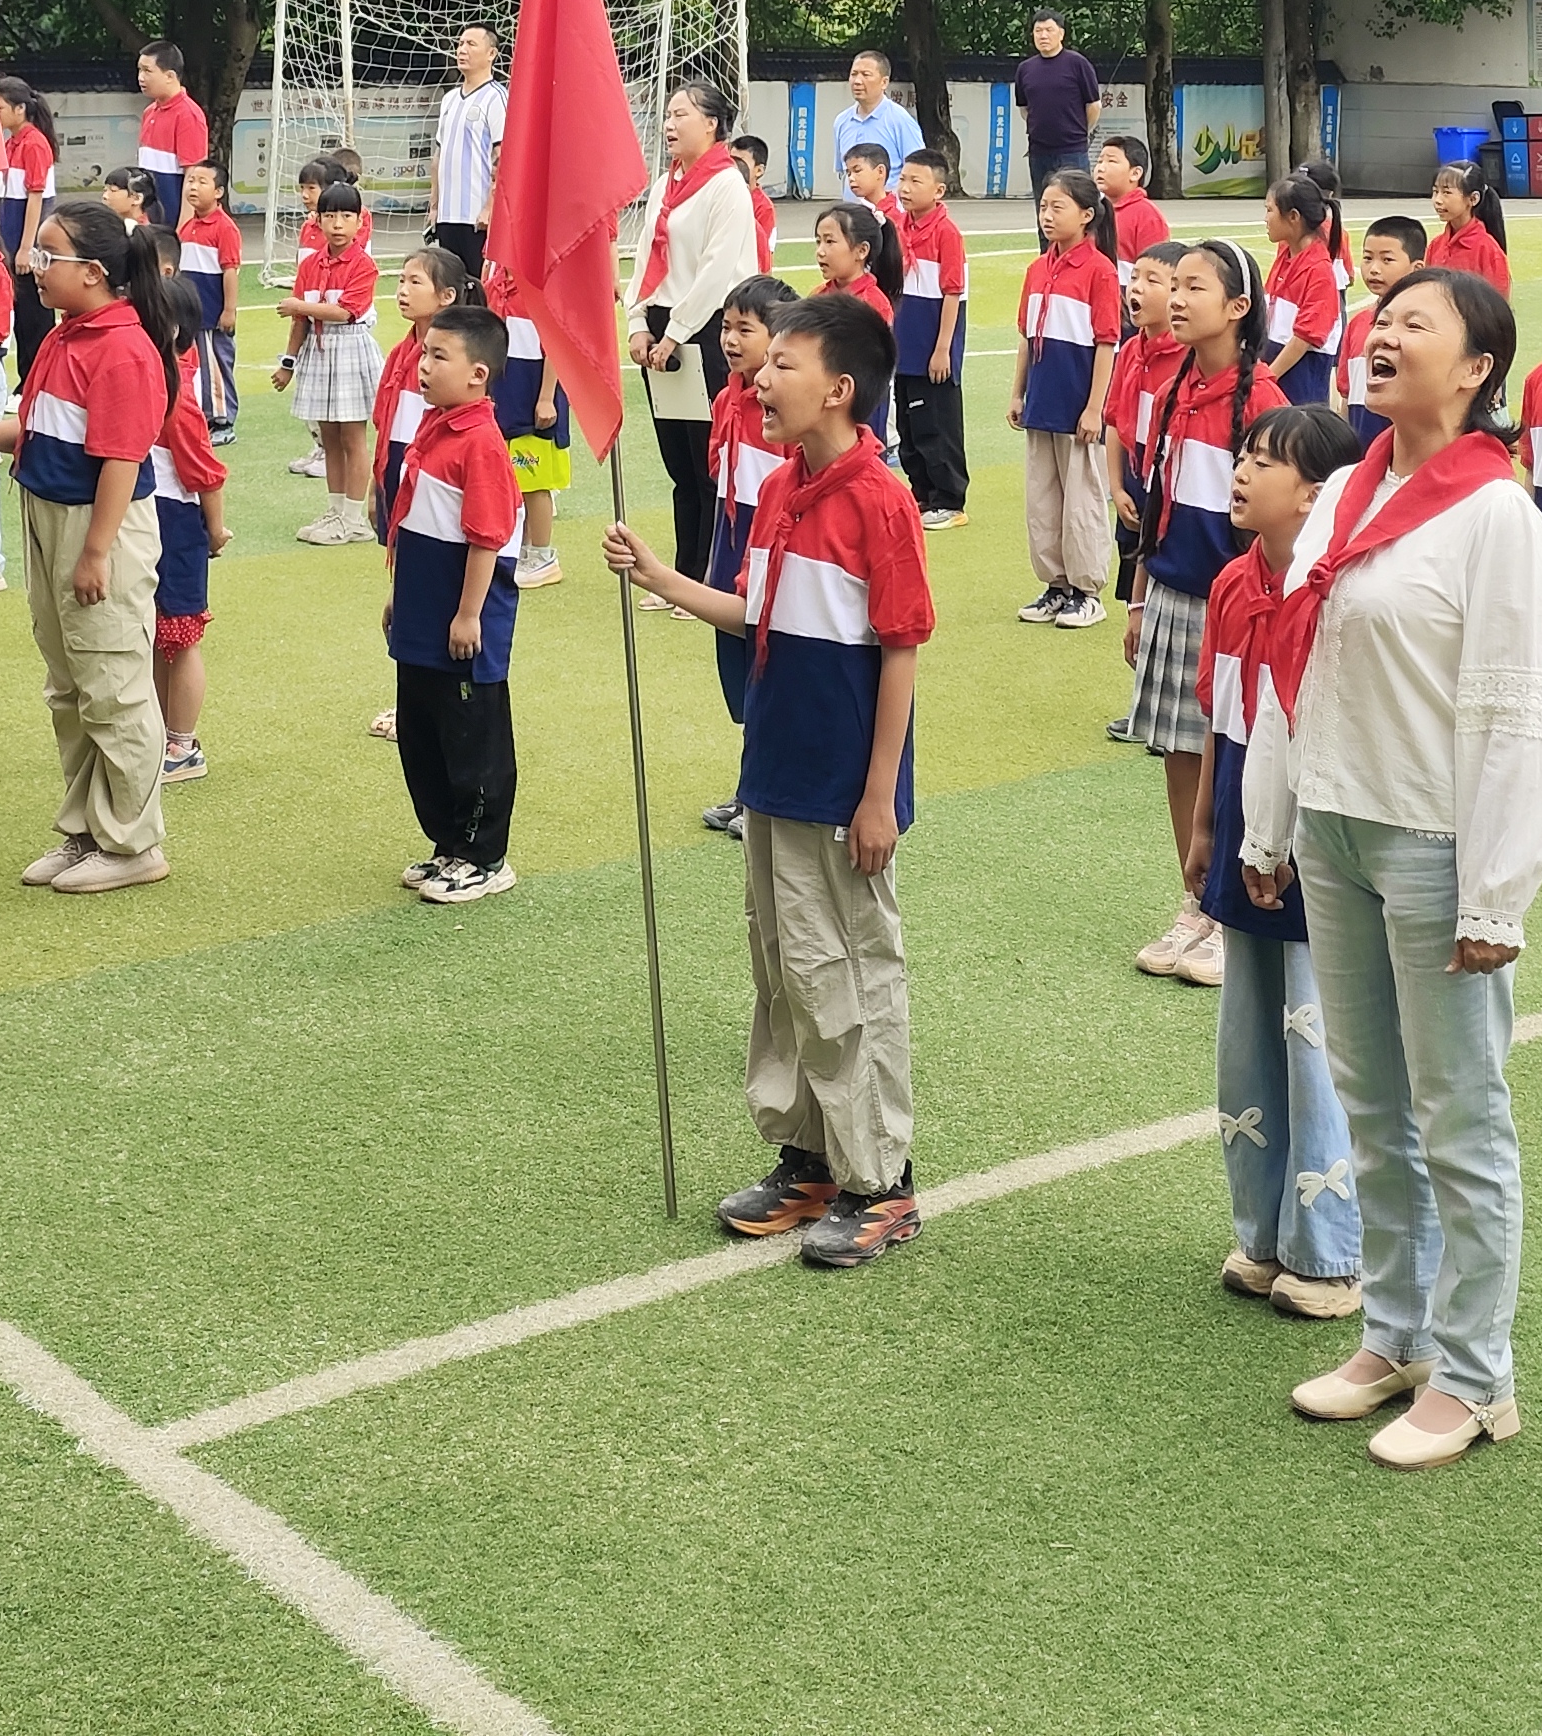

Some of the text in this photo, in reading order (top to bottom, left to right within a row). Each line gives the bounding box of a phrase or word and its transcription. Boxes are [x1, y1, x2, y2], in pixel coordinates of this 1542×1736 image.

[1101, 90, 1128, 109] 安全
[996, 106, 1005, 148] 阳光校园
[1192, 123, 1266, 174] 少儿足
